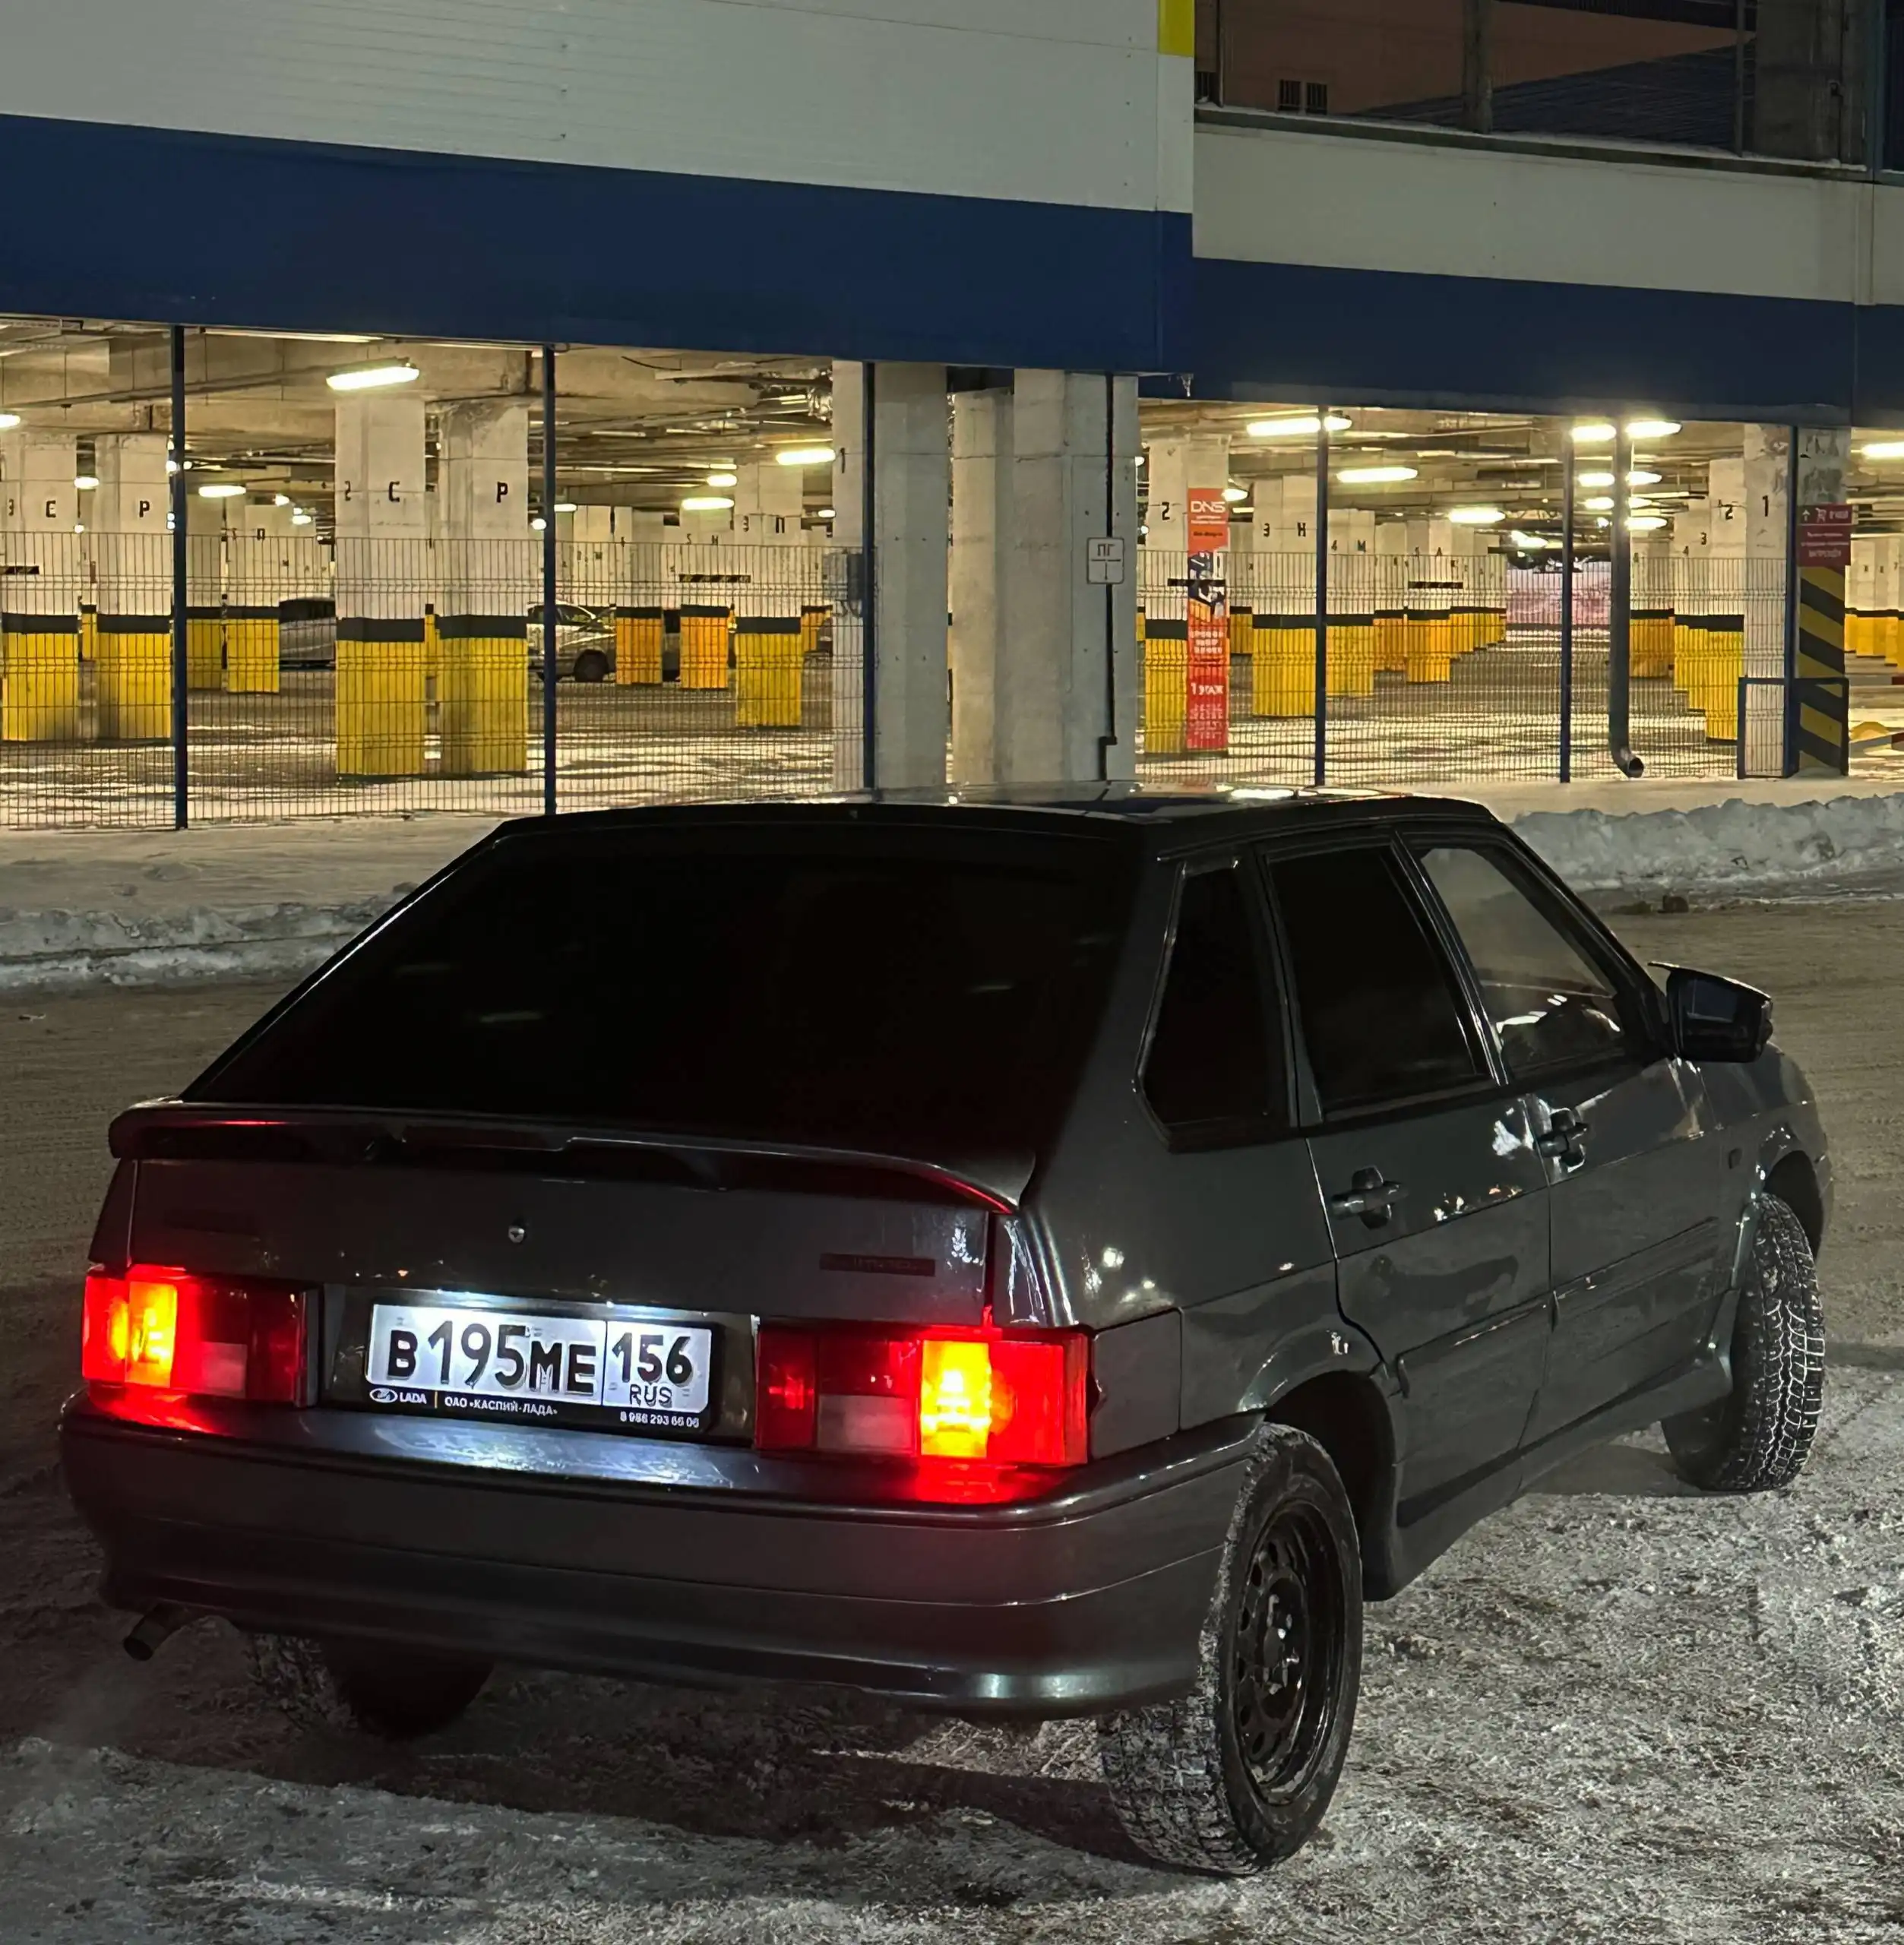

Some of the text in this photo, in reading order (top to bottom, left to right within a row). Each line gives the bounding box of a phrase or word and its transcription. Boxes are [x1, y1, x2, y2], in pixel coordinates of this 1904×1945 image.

[1162, 501, 1171, 520] 2
[1191, 501, 1226, 514] DNS
[1725, 504, 1733, 520] 2
[1762, 495, 1769, 517] 1
[1264, 523, 1270, 537] 3
[1700, 532, 1707, 546] 3
[612, 1332, 694, 1387] 156
[400, 1393, 427, 1404] LADA
[444, 1396, 468, 1409] ОАО
[629, 1384, 673, 1409] RUS
